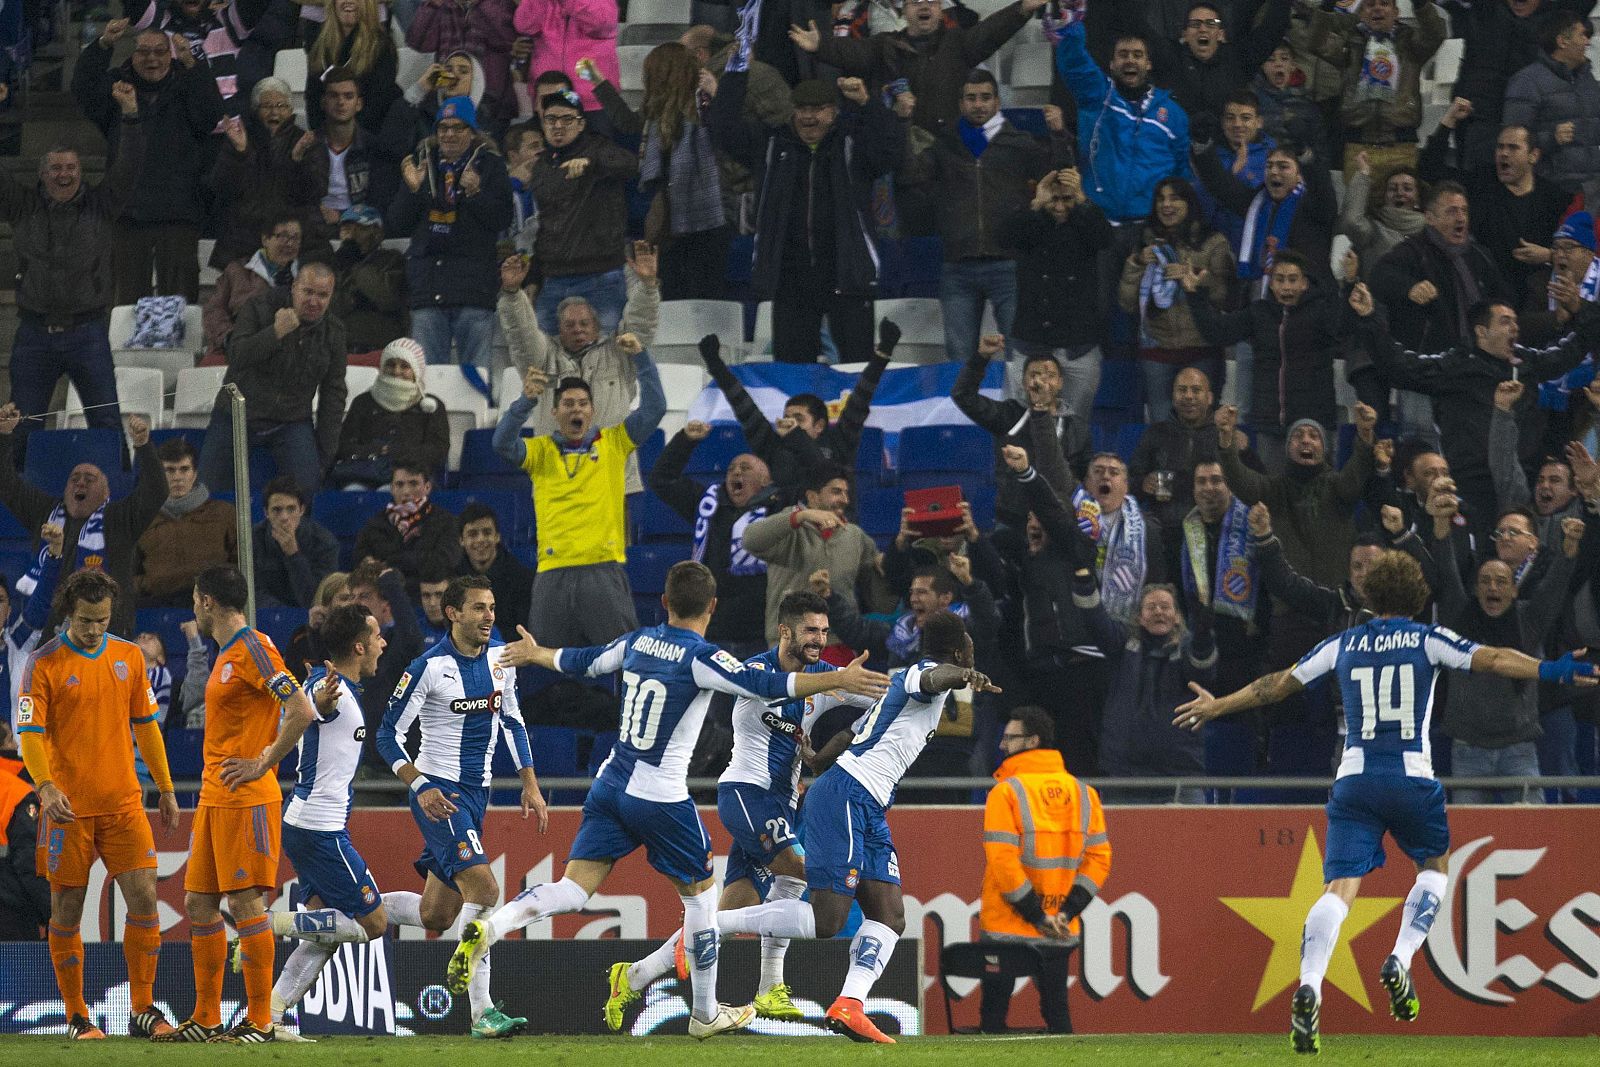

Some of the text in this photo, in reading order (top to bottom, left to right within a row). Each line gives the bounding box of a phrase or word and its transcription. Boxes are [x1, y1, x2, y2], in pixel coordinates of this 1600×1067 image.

[631, 635, 686, 663] ABRAHAM
[1345, 630, 1420, 653] J. A. CAÑAS
[620, 670, 667, 751] 10
[1350, 663, 1416, 740] 14
[466, 829, 484, 855] 8
[765, 816, 796, 845] 22
